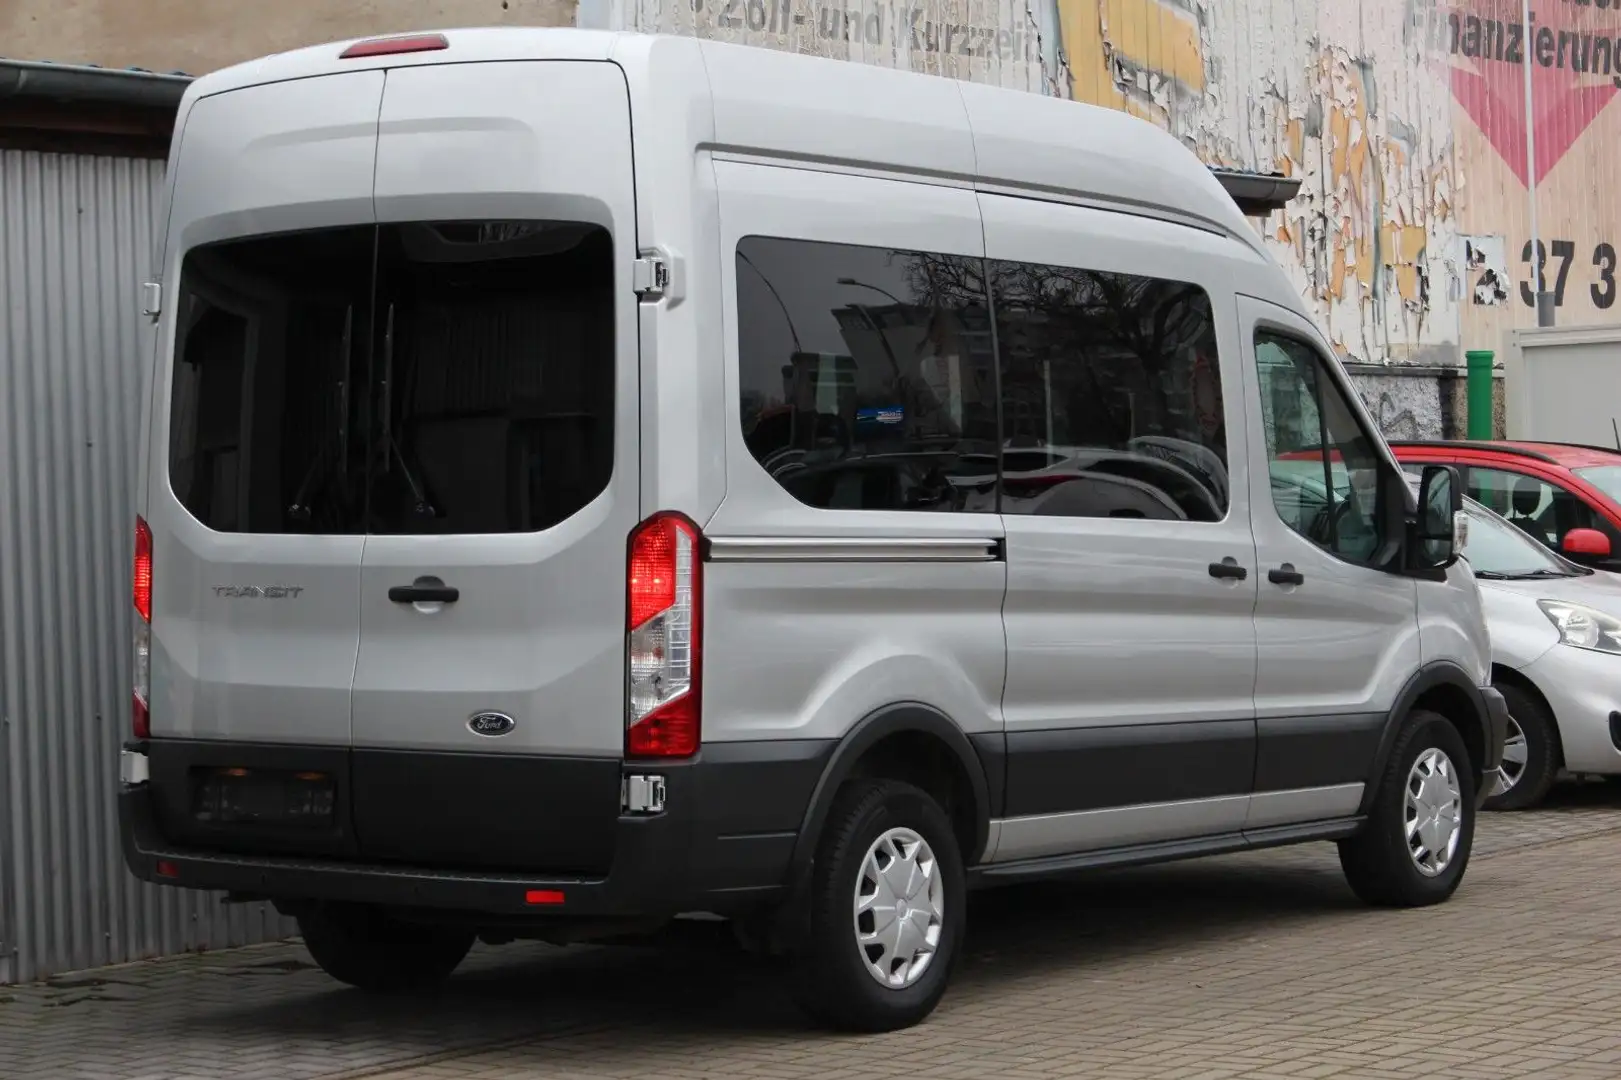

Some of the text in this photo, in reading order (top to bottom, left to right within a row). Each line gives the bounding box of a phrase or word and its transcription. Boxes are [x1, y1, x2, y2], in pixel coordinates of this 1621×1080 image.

[818, 3, 886, 48] und
[1519, 239, 1576, 308] 37
[1590, 242, 1617, 309] 3
[211, 584, 306, 599] TRANSIT
